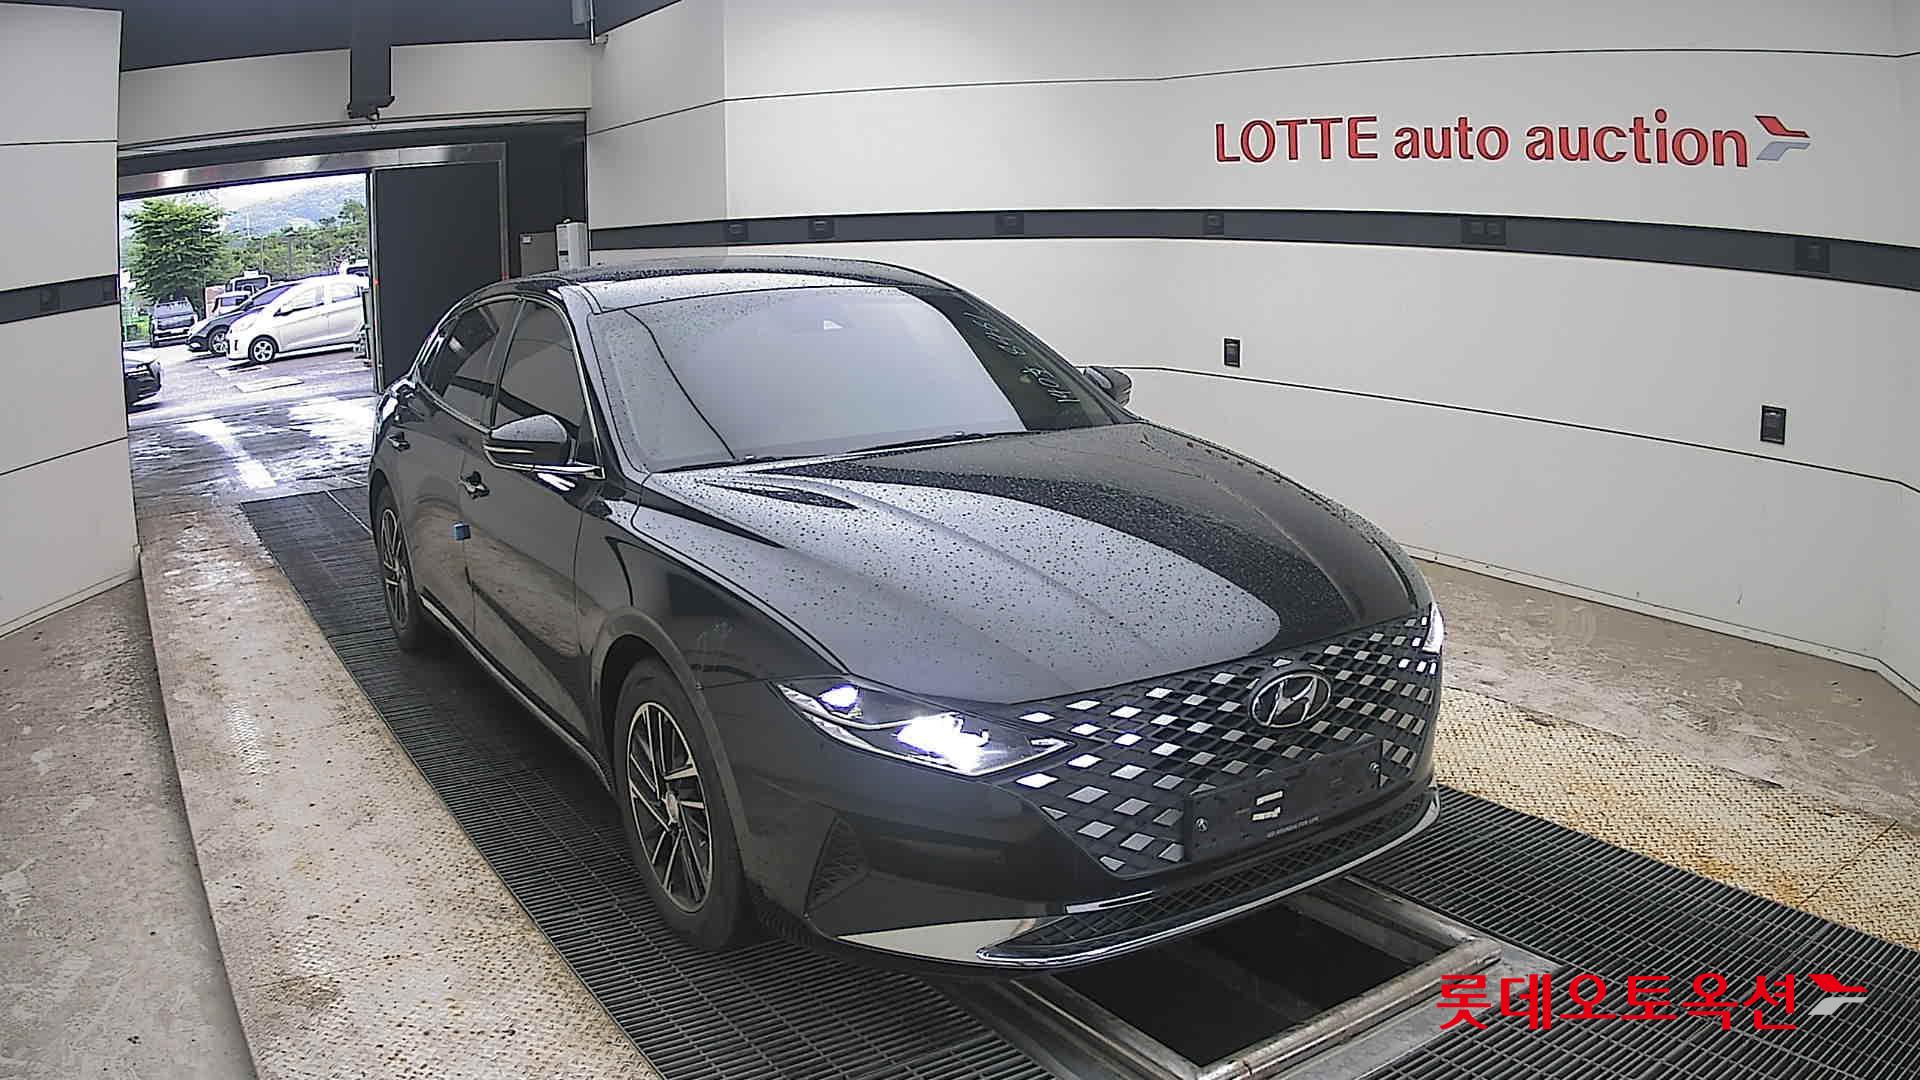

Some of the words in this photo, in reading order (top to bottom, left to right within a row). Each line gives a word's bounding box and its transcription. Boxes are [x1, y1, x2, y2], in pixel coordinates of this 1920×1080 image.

[1215, 116, 1378, 163] LOTTE
[1394, 117, 1510, 160] auto
[1525, 109, 1749, 167] auction
